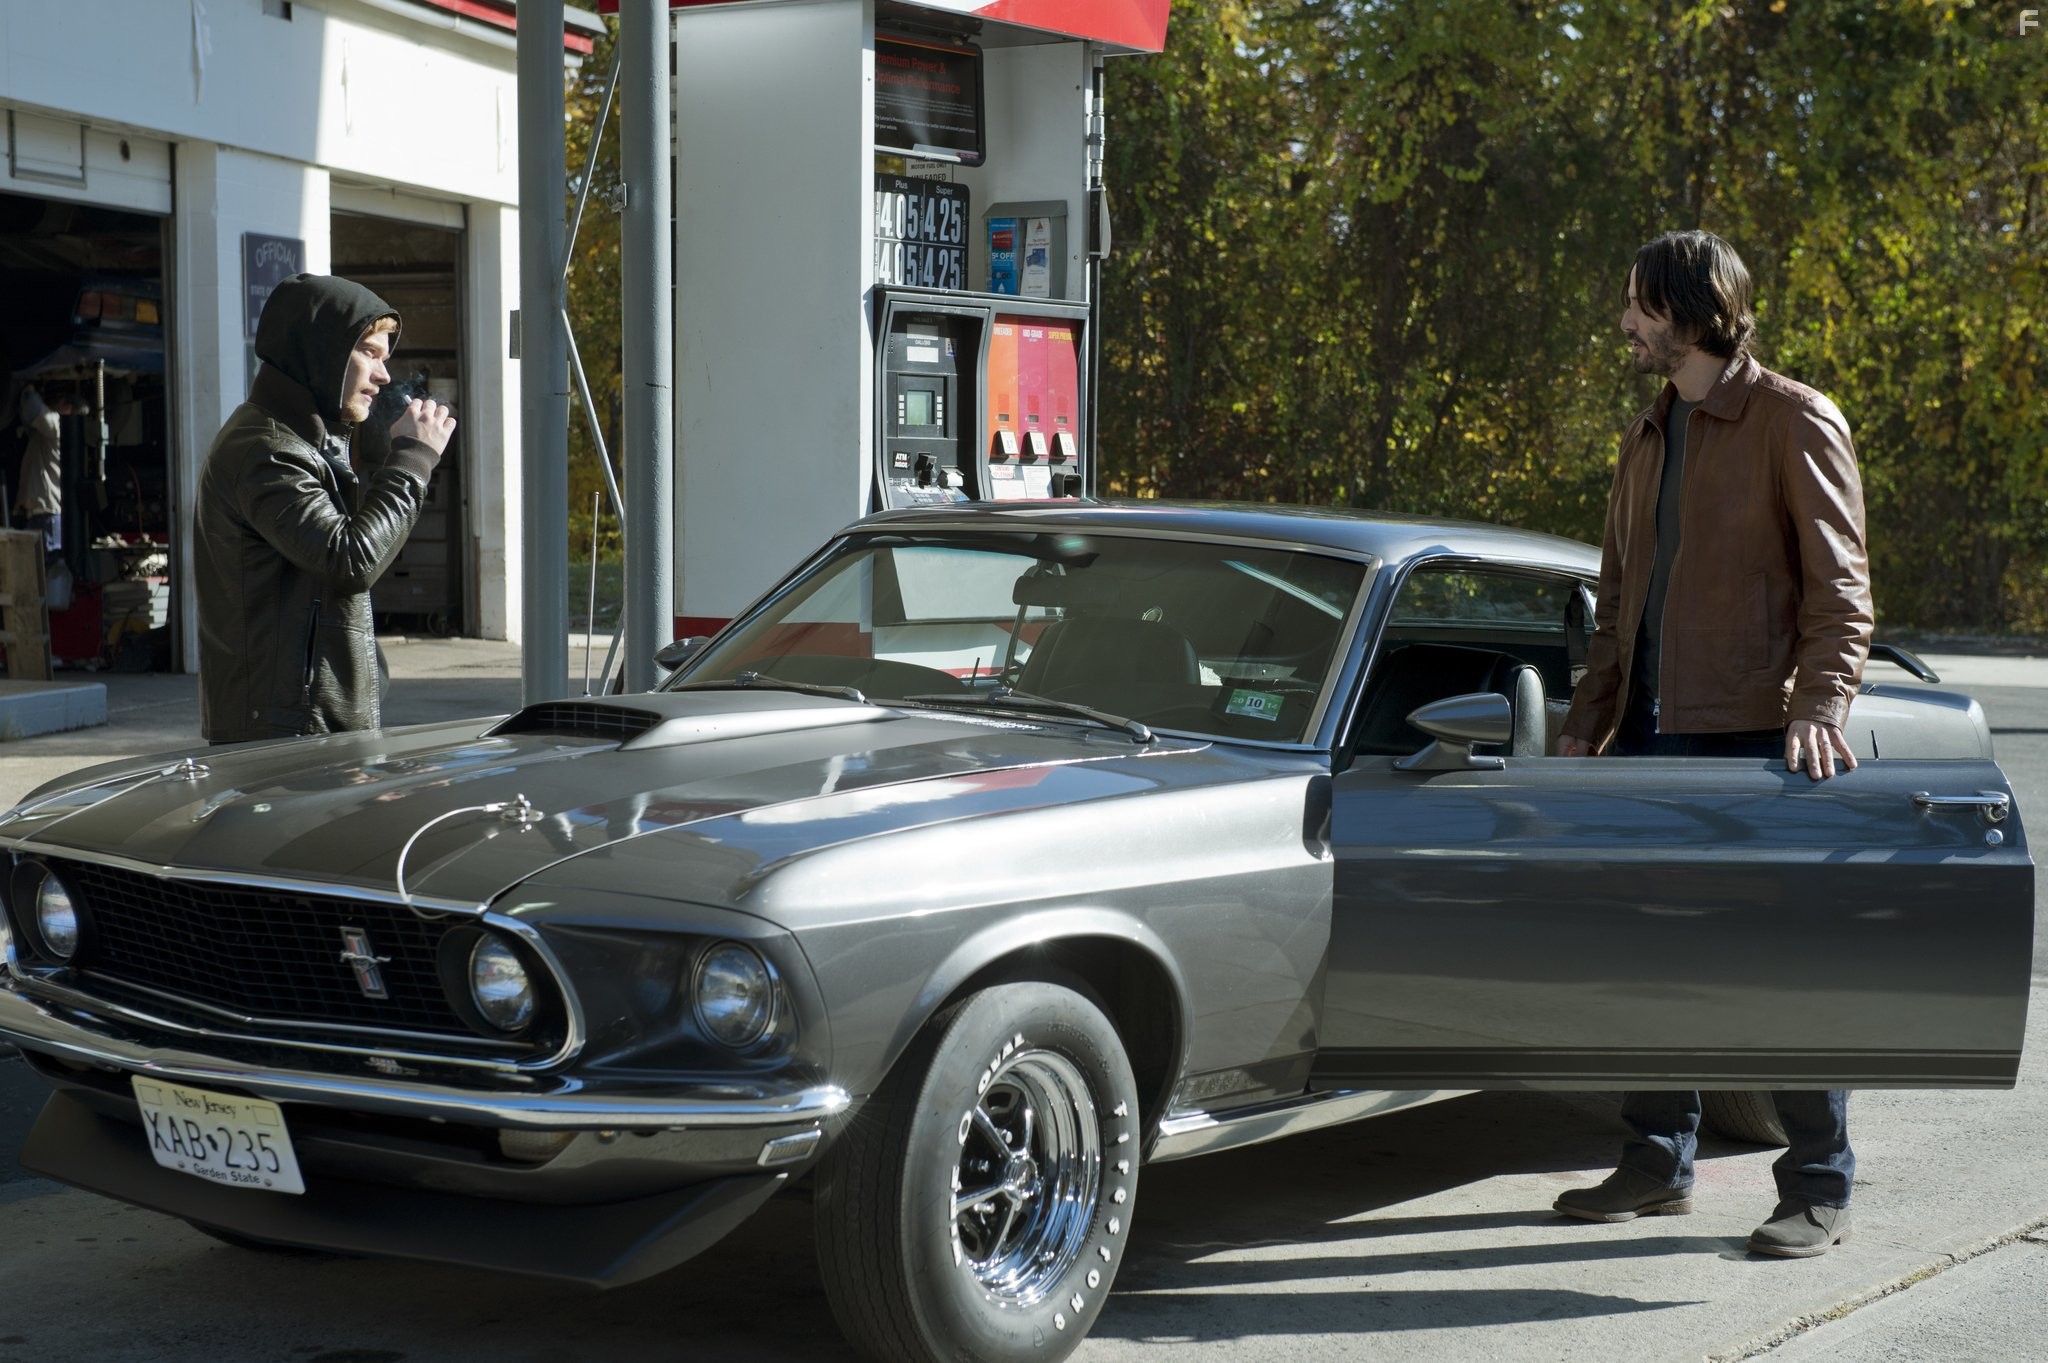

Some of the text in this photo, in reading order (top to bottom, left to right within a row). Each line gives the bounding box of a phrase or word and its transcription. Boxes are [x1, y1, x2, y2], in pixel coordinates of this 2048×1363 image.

[939, 62, 946, 74] &
[895, 180, 908, 189] Plus
[935, 185, 953, 195] Super
[880, 192, 918, 239] 4.05
[924, 197, 961, 243] 4.25
[255, 241, 297, 272] OFFICIAL
[1000, 252, 1015, 260] OFF
[1247, 697, 1263, 708] 10
[173, 1089, 236, 1119] New Jersey
[217, 1126, 279, 1173] 235
[193, 1162, 261, 1185] Garden State
